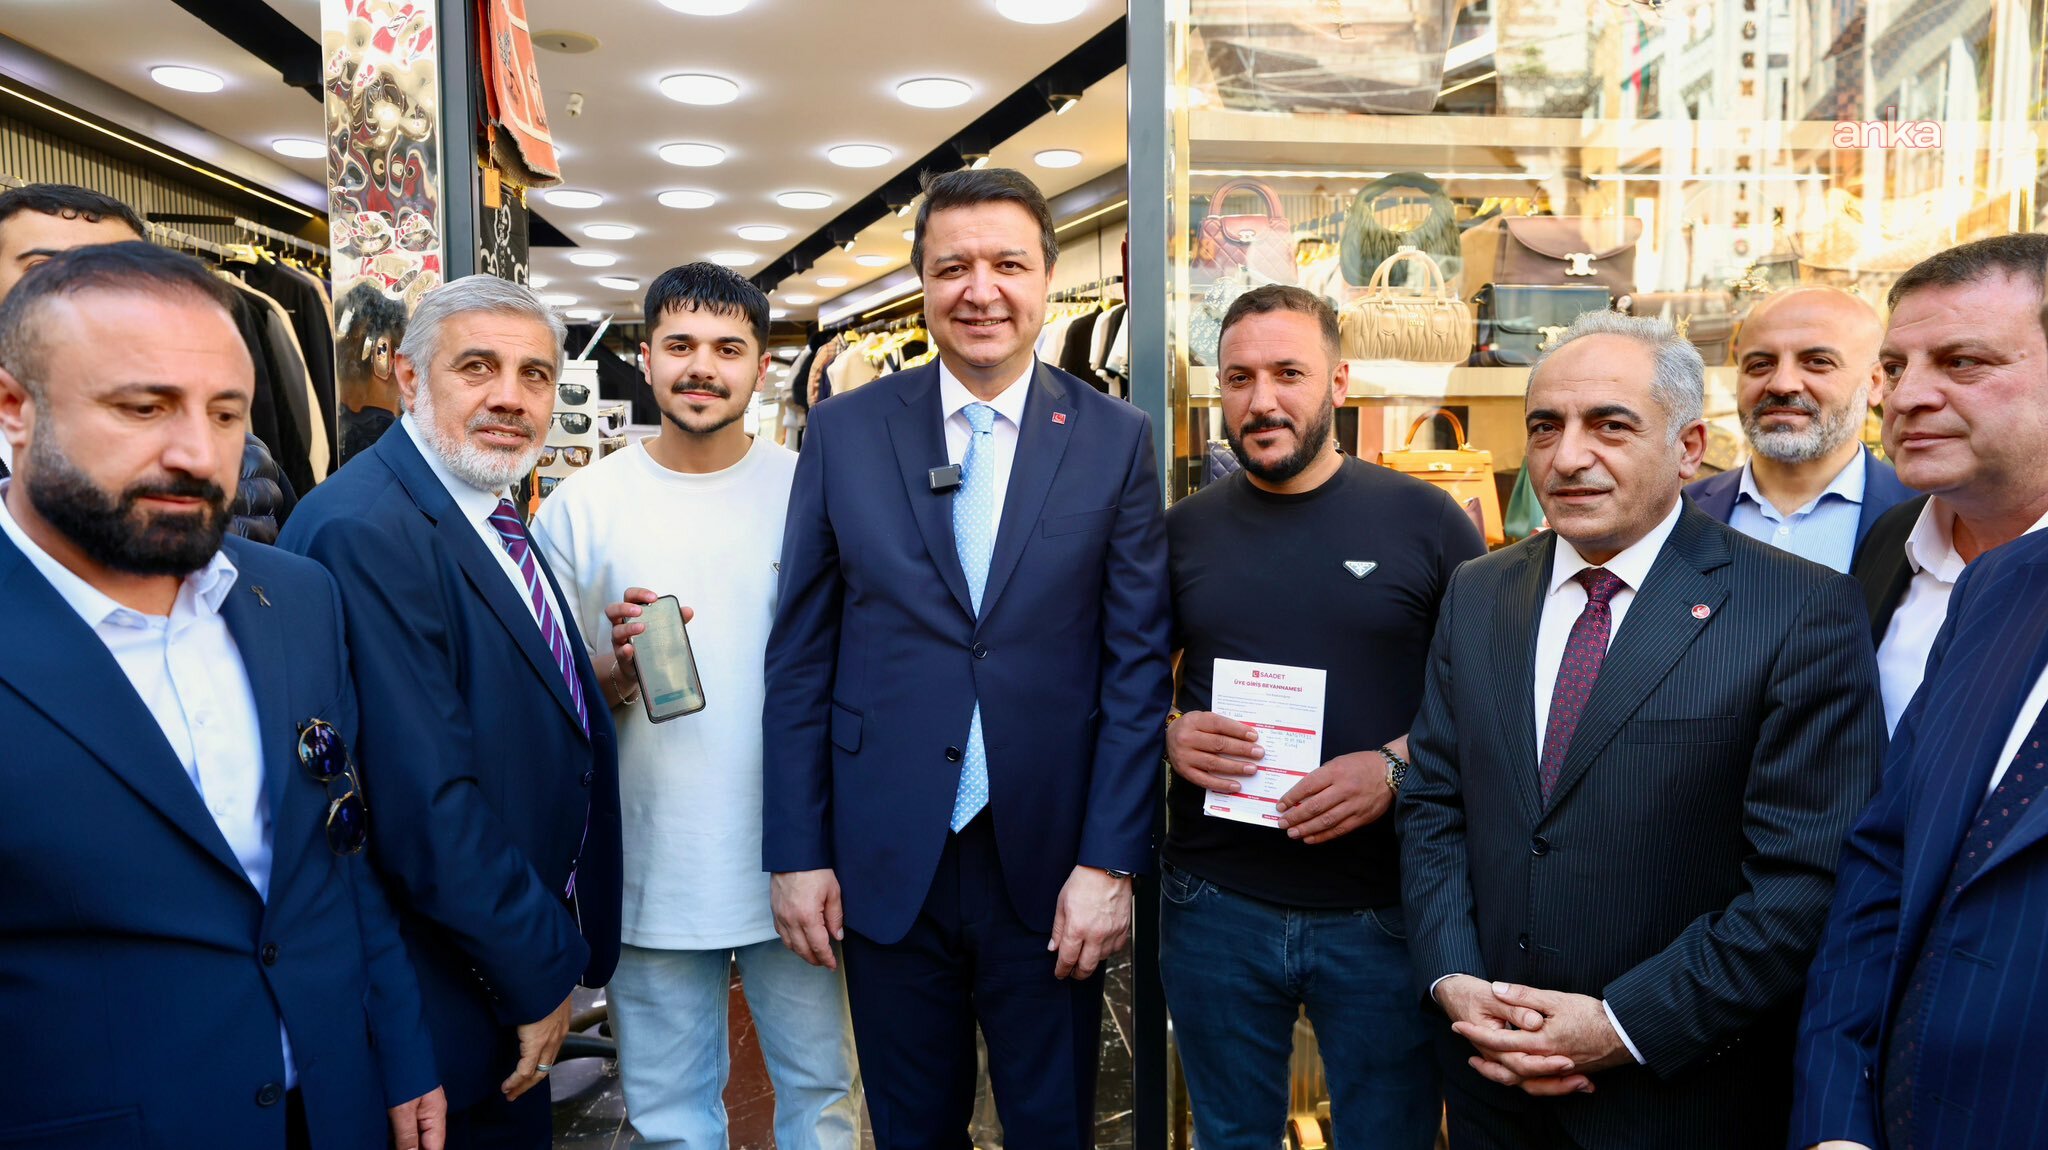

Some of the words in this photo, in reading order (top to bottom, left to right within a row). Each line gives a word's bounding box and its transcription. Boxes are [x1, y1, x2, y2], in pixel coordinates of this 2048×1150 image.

[1260, 671, 1286, 680] SAADET
[1246, 680, 1261, 688] GİRİŞ
[1262, 683, 1303, 693] BEYANNAMESİ
